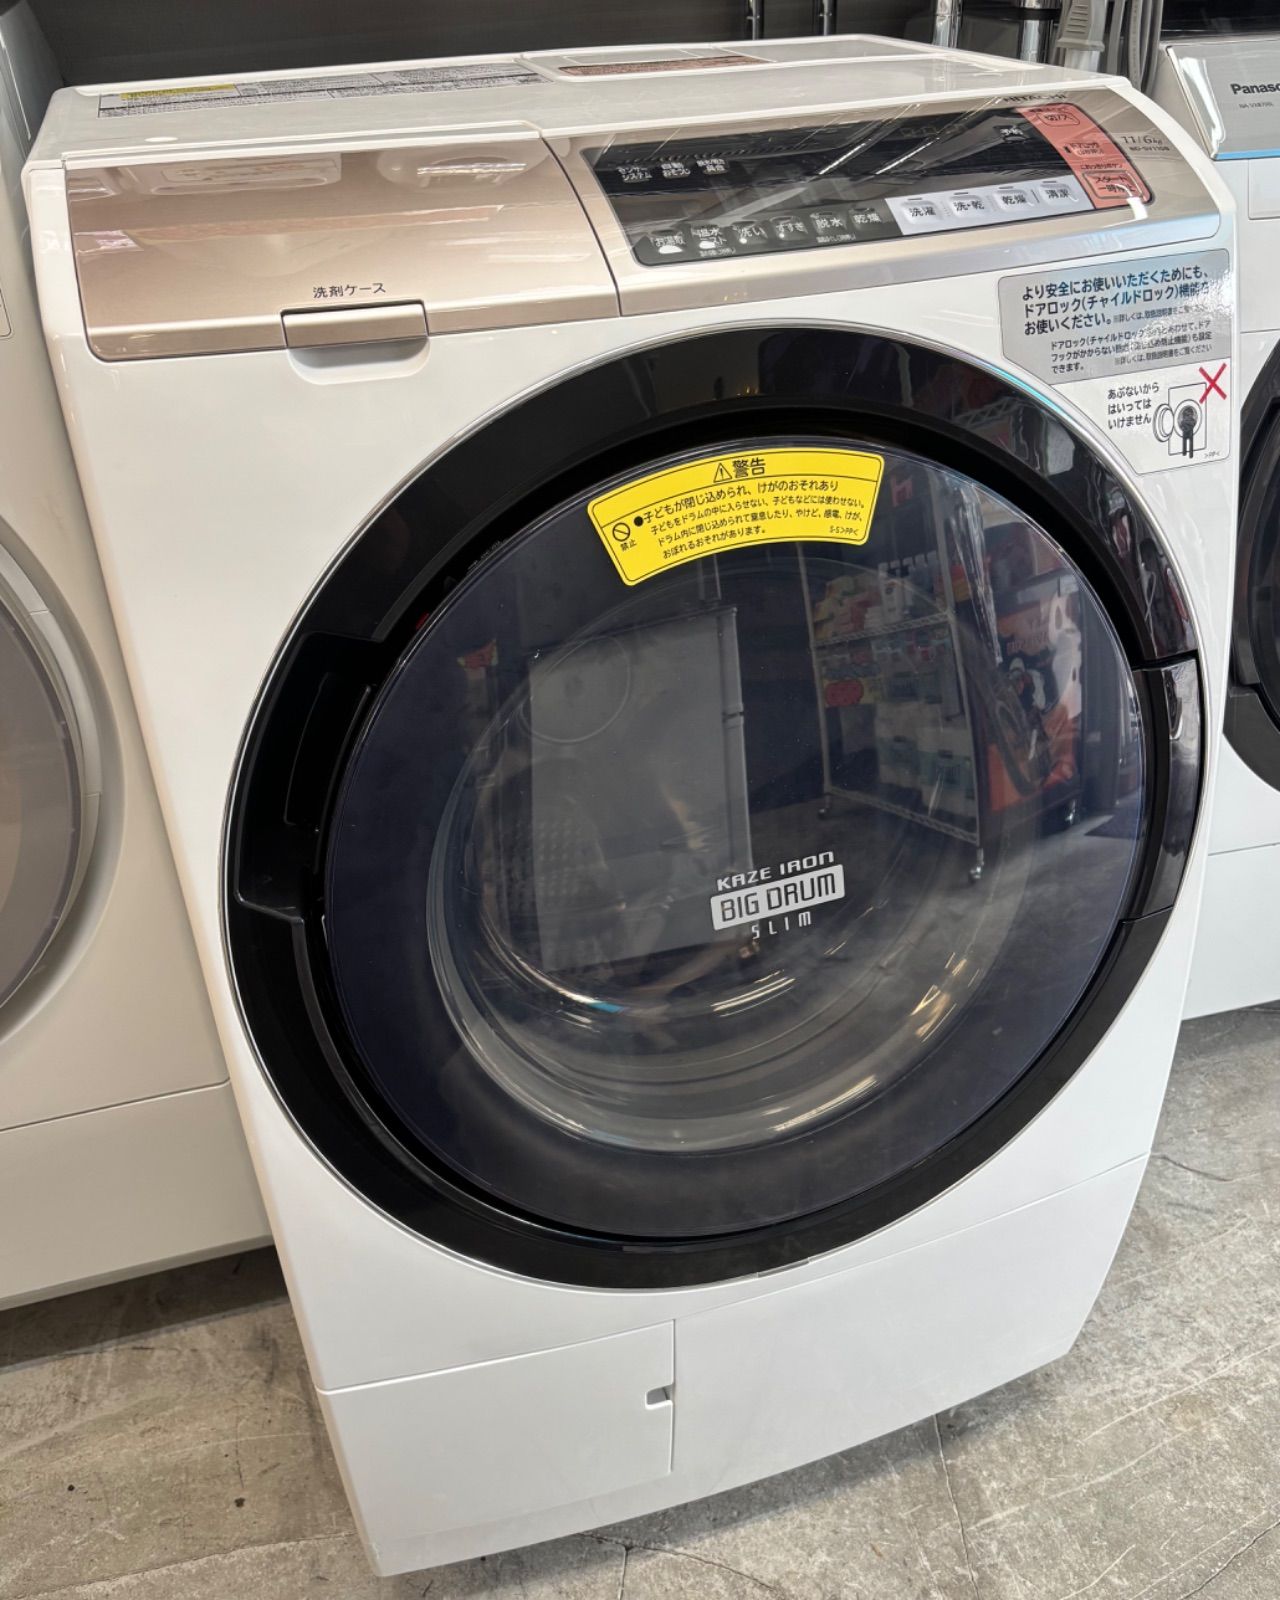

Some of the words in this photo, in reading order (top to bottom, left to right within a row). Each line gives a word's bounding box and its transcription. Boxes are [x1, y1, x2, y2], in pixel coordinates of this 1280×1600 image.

[909, 207, 937, 217] 洗濯
[816, 218, 843, 229] 脱水
[313, 282, 386, 299] 洗剤ケース
[1022, 265, 1209, 301] より安全にお使いいただくためにも、
[1024, 312, 1112, 336] お使いください。
[1052, 362, 1084, 374] できます。
[1107, 382, 1160, 399] あぶないから
[1108, 399, 1152, 415] はいっては
[1108, 413, 1152, 430] いけません
[732, 457, 765, 479] 警告
[620, 539, 637, 552] 禁止
[717, 866, 772, 891] KAZE
[780, 851, 835, 876] IRON
[720, 892, 760, 922] BIG
[766, 873, 836, 910] DRUM
[752, 911, 812, 940] SLIM
